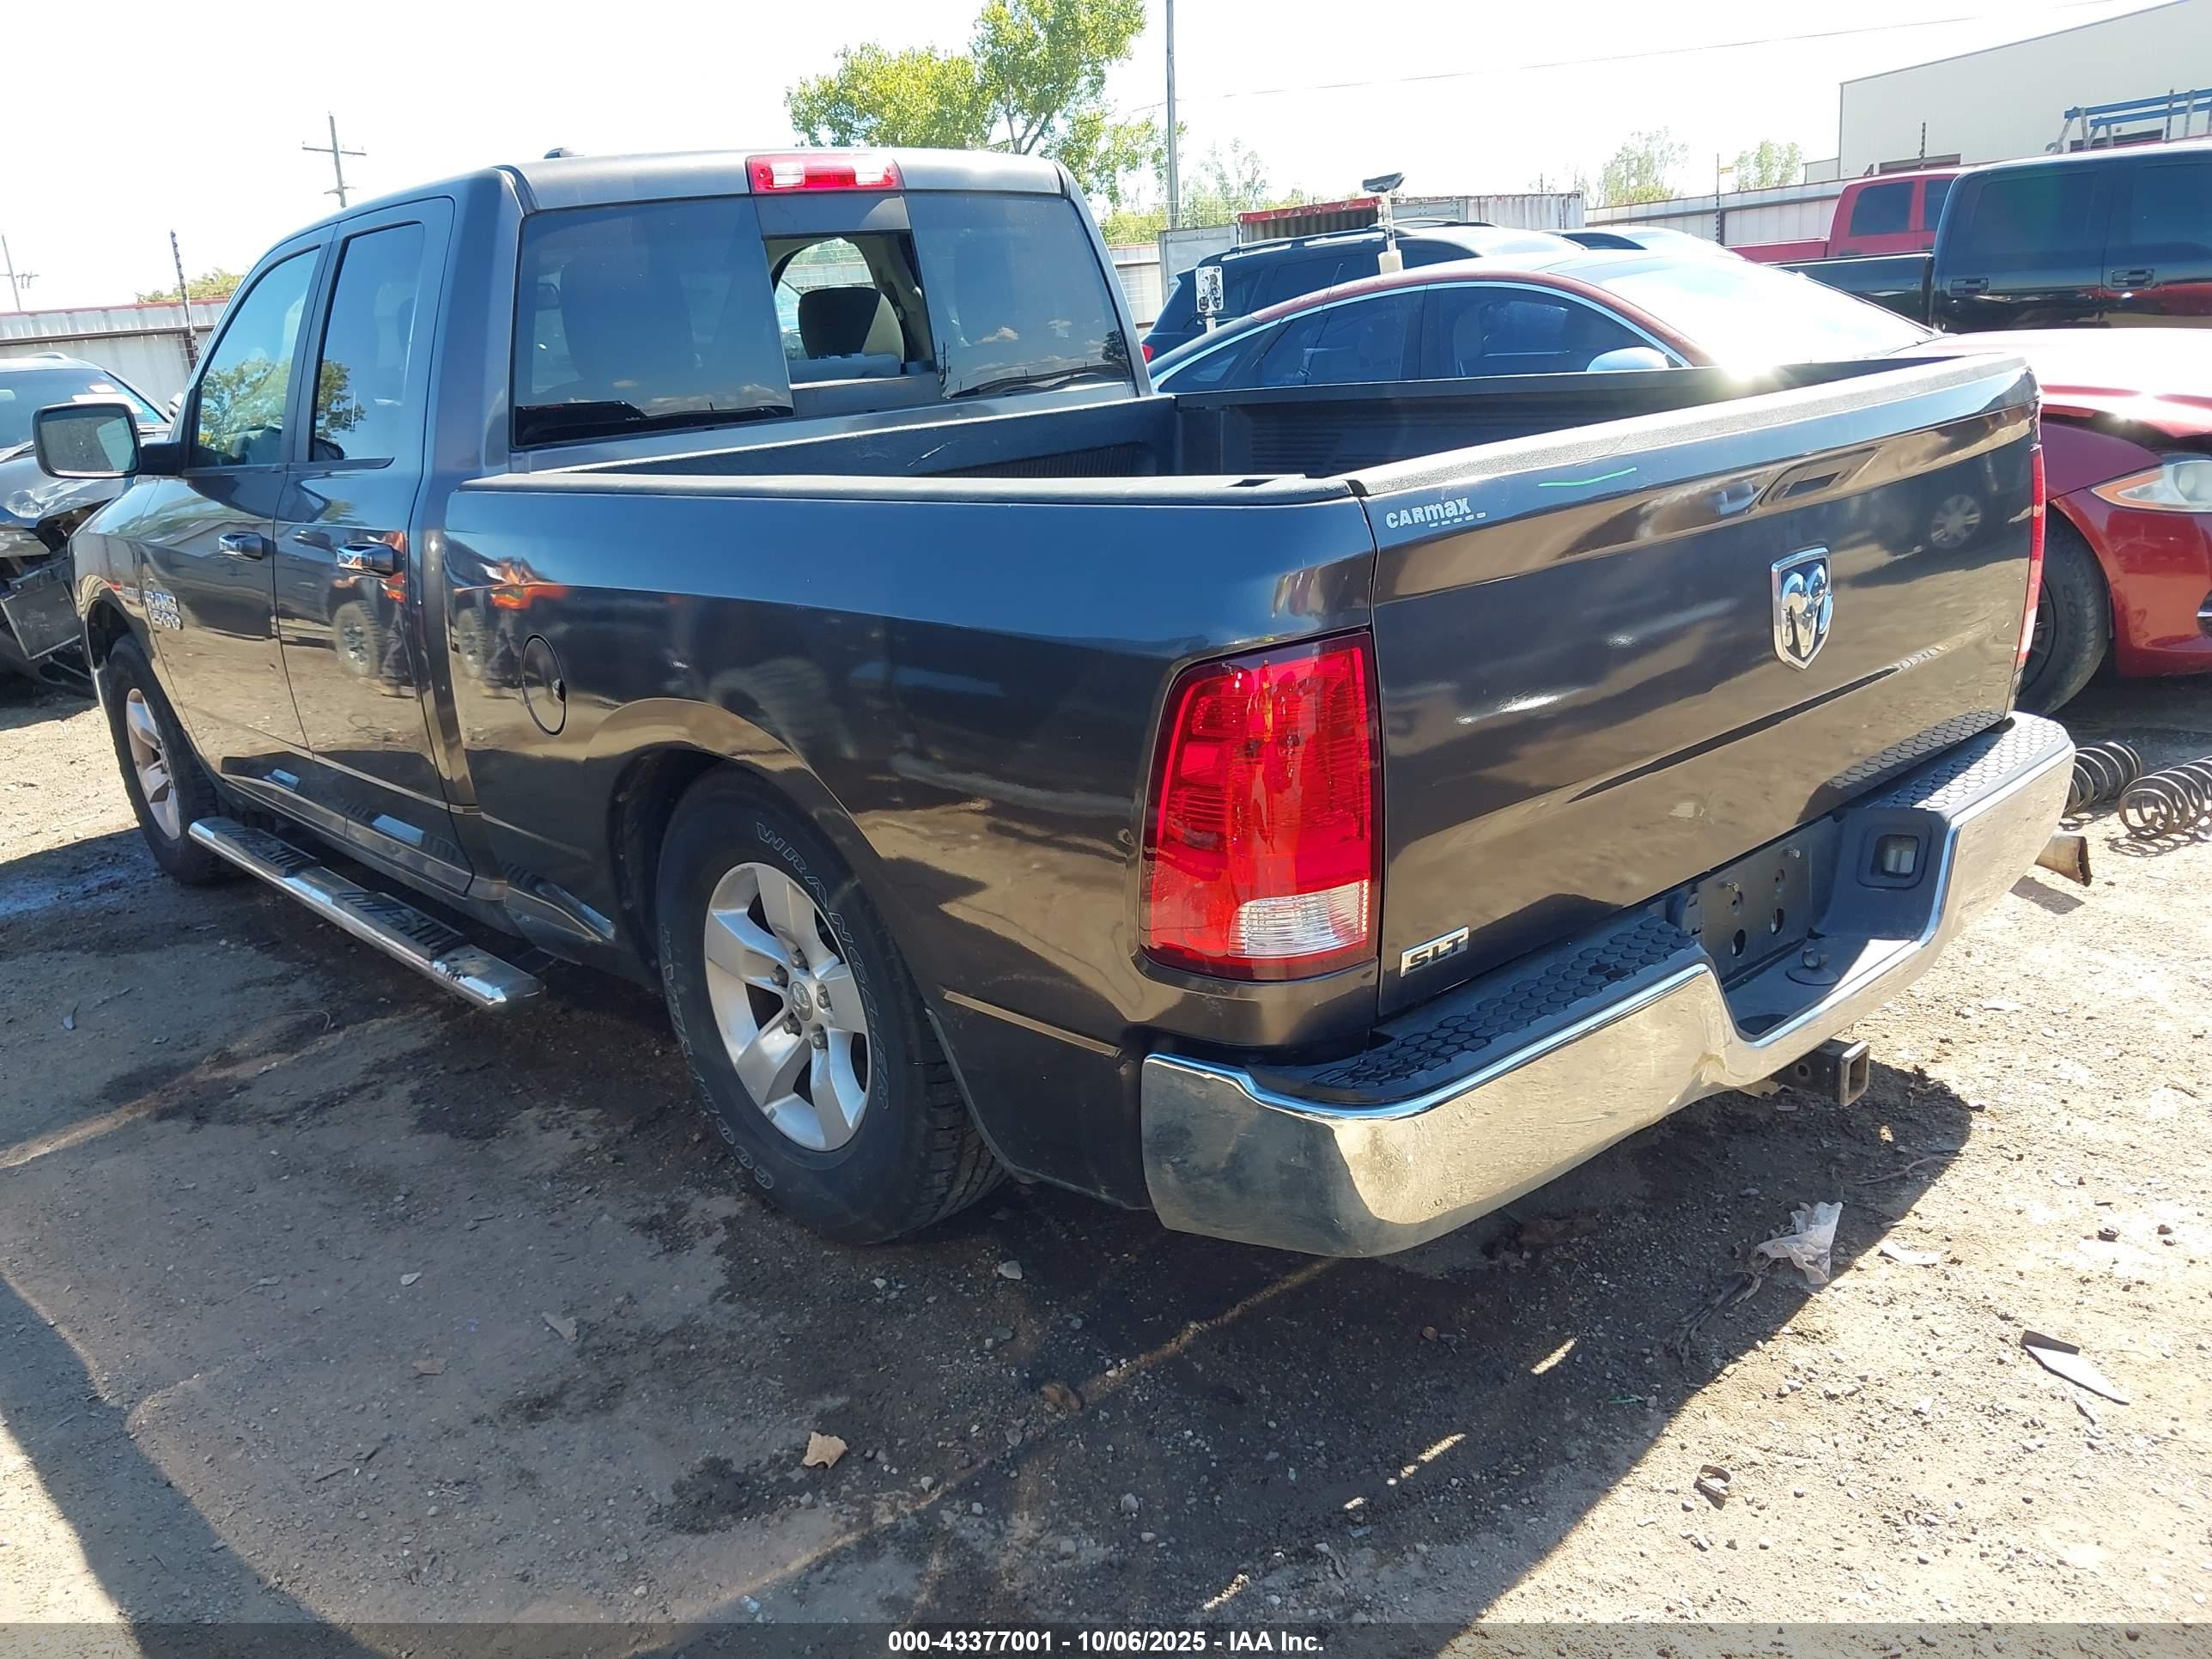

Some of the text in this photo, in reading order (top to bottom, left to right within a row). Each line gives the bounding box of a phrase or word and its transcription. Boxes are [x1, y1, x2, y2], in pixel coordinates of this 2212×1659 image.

[144, 590, 178, 612] RAM
[756, 821, 890, 1110] WRANGLER
[1404, 933, 1465, 971] SLT
